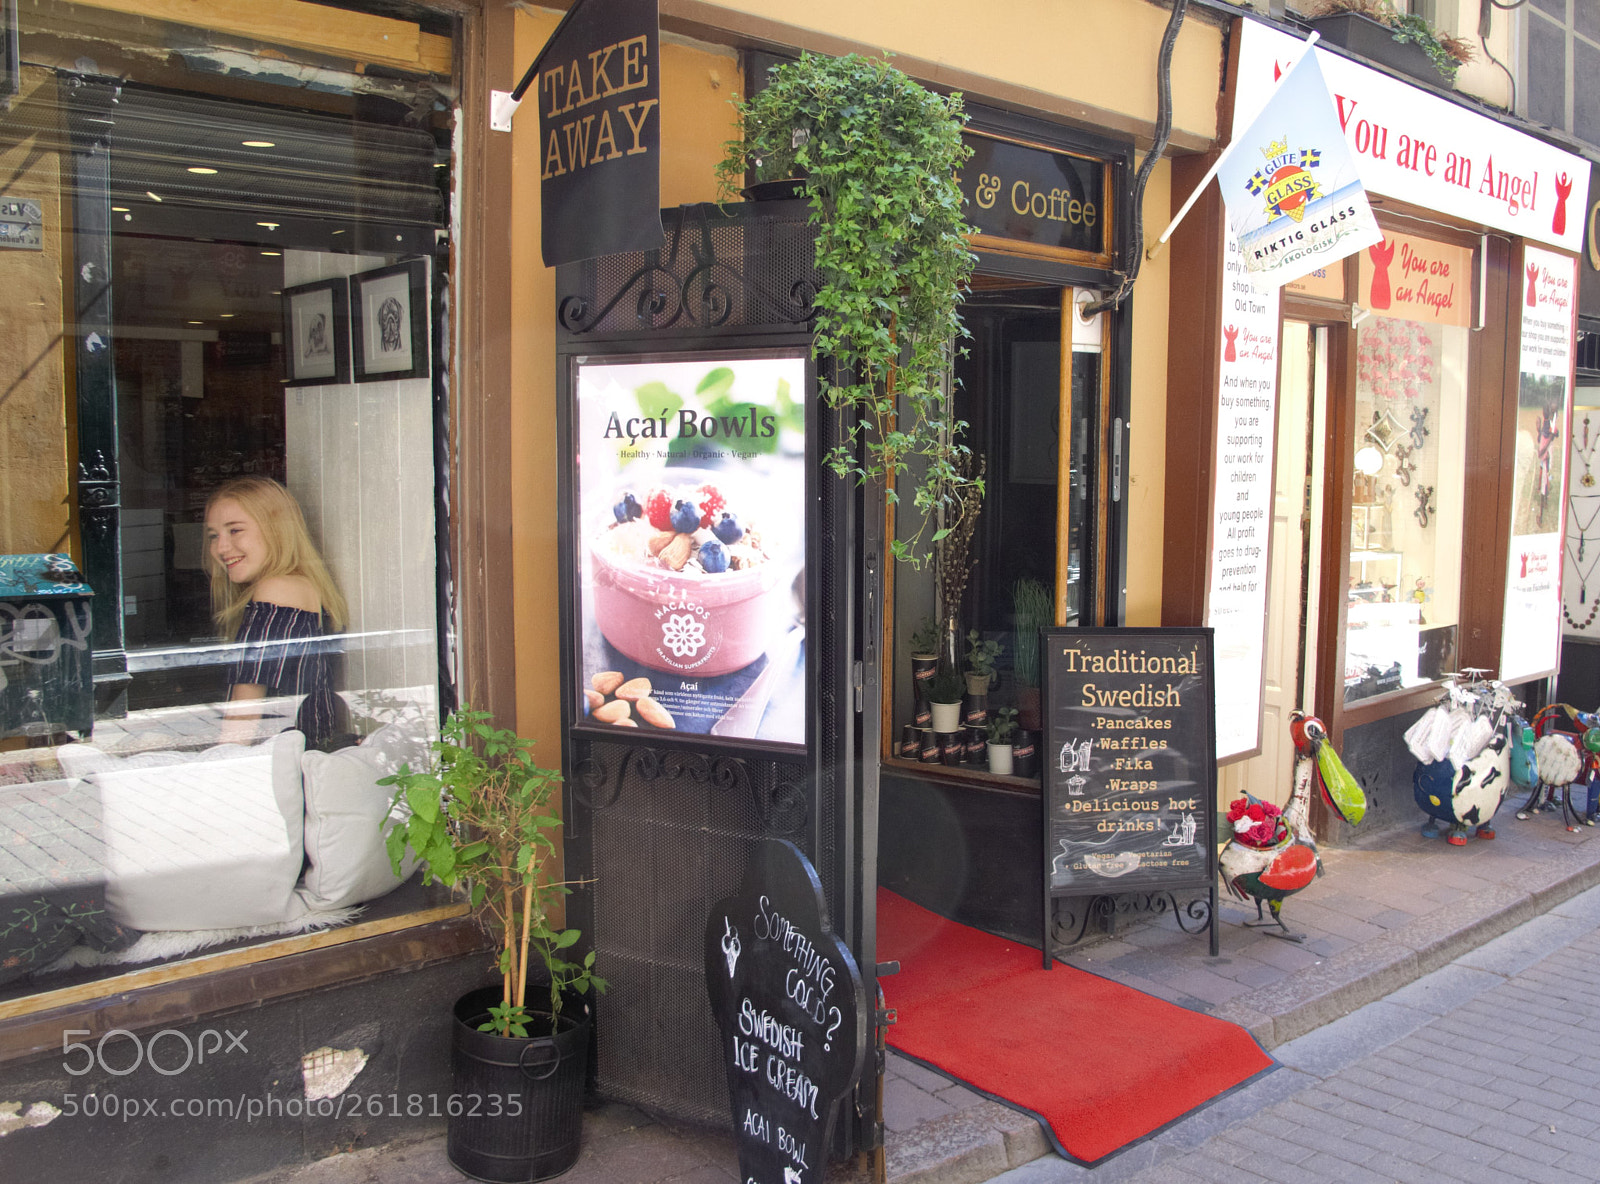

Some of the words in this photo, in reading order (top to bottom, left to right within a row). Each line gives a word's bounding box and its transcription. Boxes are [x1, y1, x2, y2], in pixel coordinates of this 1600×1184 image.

[544, 34, 648, 119] TAKE
[541, 98, 658, 181] AWAY
[1334, 93, 1388, 160] You
[1397, 134, 1437, 177] are
[1444, 152, 1471, 189] an
[1479, 153, 1538, 216] Angel
[1264, 153, 1297, 175] GUTE
[1267, 175, 1312, 205] GLASS
[975, 173, 1001, 209] &
[1011, 180, 1096, 227] Coffee
[1254, 231, 1304, 260] RIKTIG
[1310, 206, 1356, 233] GLASS
[1284, 238, 1334, 265] EKOLOGISK
[1227, 260, 1241, 275] only
[1401, 243, 1427, 279] You
[1430, 260, 1450, 277] are
[1232, 281, 1248, 294] shop
[1396, 286, 1413, 302] an
[1416, 278, 1454, 317] Angel
[1235, 299, 1247, 312] Old
[1248, 300, 1266, 315] Town
[1242, 326, 1258, 345] You
[1260, 335, 1272, 344] are
[1239, 349, 1249, 358] an
[1252, 345, 1274, 365] Angel
[1224, 375, 1238, 387] And
[1240, 377, 1257, 388] when
[1259, 379, 1270, 392] you
[1221, 394, 1234, 409] buy
[603, 407, 669, 446] Açaí
[678, 407, 775, 438] Bowls
[1235, 417, 1247, 428] you
[1249, 417, 1259, 426] are
[1227, 434, 1263, 448] supporting
[620, 450, 650, 460] Healthy
[656, 450, 687, 458] Natural
[693, 450, 725, 460] Organic
[731, 451, 758, 460] Vegan
[1224, 454, 1235, 464] our
[1237, 452, 1253, 464] work
[1255, 452, 1264, 463] for
[1231, 471, 1256, 483] children
[1236, 490, 1249, 501] and
[1219, 510, 1240, 524] young
[1242, 508, 1263, 522] people
[1227, 527, 1236, 539] All
[1238, 526, 1255, 541] profit
[1219, 548, 1234, 562] goes
[1236, 546, 1242, 557] to
[1222, 564, 1256, 580] prevention
[654, 601, 711, 620] MACACOS
[656, 647, 683, 669] BRAZILIAN
[684, 646, 716, 669] SUPERFRUITS
[1063, 649, 1198, 674] Traditional
[680, 681, 698, 691] Açaí
[1082, 683, 1181, 707] Swedish
[1096, 717, 1172, 729] Pancakes
[1100, 737, 1168, 750] Waffles
[1116, 758, 1153, 770] Fika
[1109, 778, 1158, 794] Wraps
[1072, 799, 1160, 812] Delicious
[1169, 797, 1197, 811] hot
[1097, 818, 1161, 832] drinks!
[1092, 852, 1116, 860] Vegan
[754, 895, 836, 1003] SOMETHING
[738, 997, 805, 1062] SWEDISH
[733, 1035, 760, 1072] ICE
[766, 1054, 819, 1119] CREAM
[744, 1108, 770, 1143] ACAI
[778, 1126, 809, 1170] BOWL
